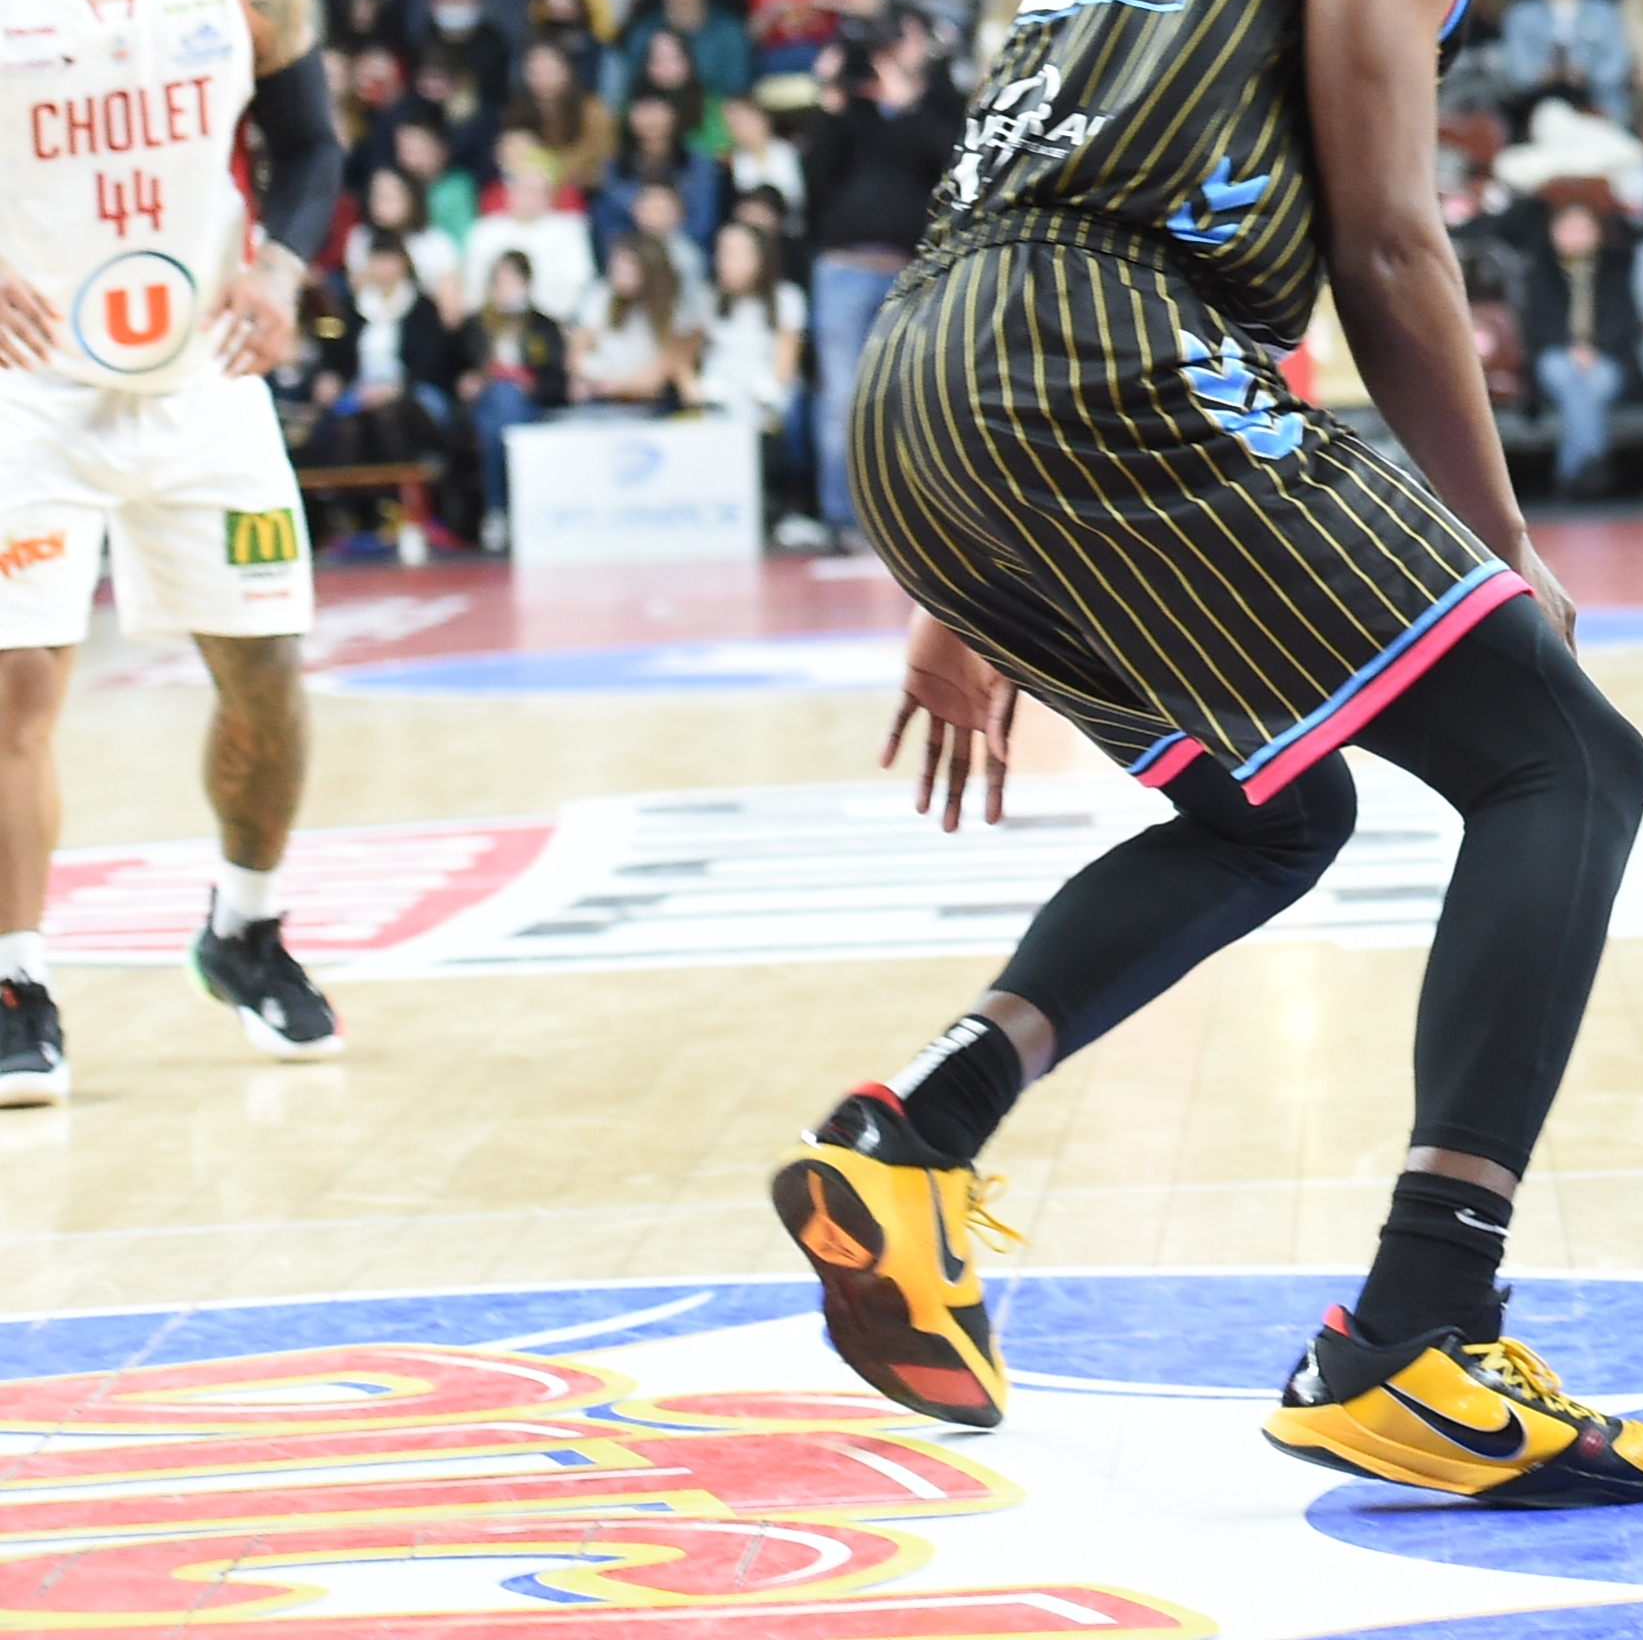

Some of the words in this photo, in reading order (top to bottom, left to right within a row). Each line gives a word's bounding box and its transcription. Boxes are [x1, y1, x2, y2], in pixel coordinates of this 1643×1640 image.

[31, 77, 214, 160] CHOLET
[95, 171, 165, 238] 44
[105, 284, 171, 347] U
